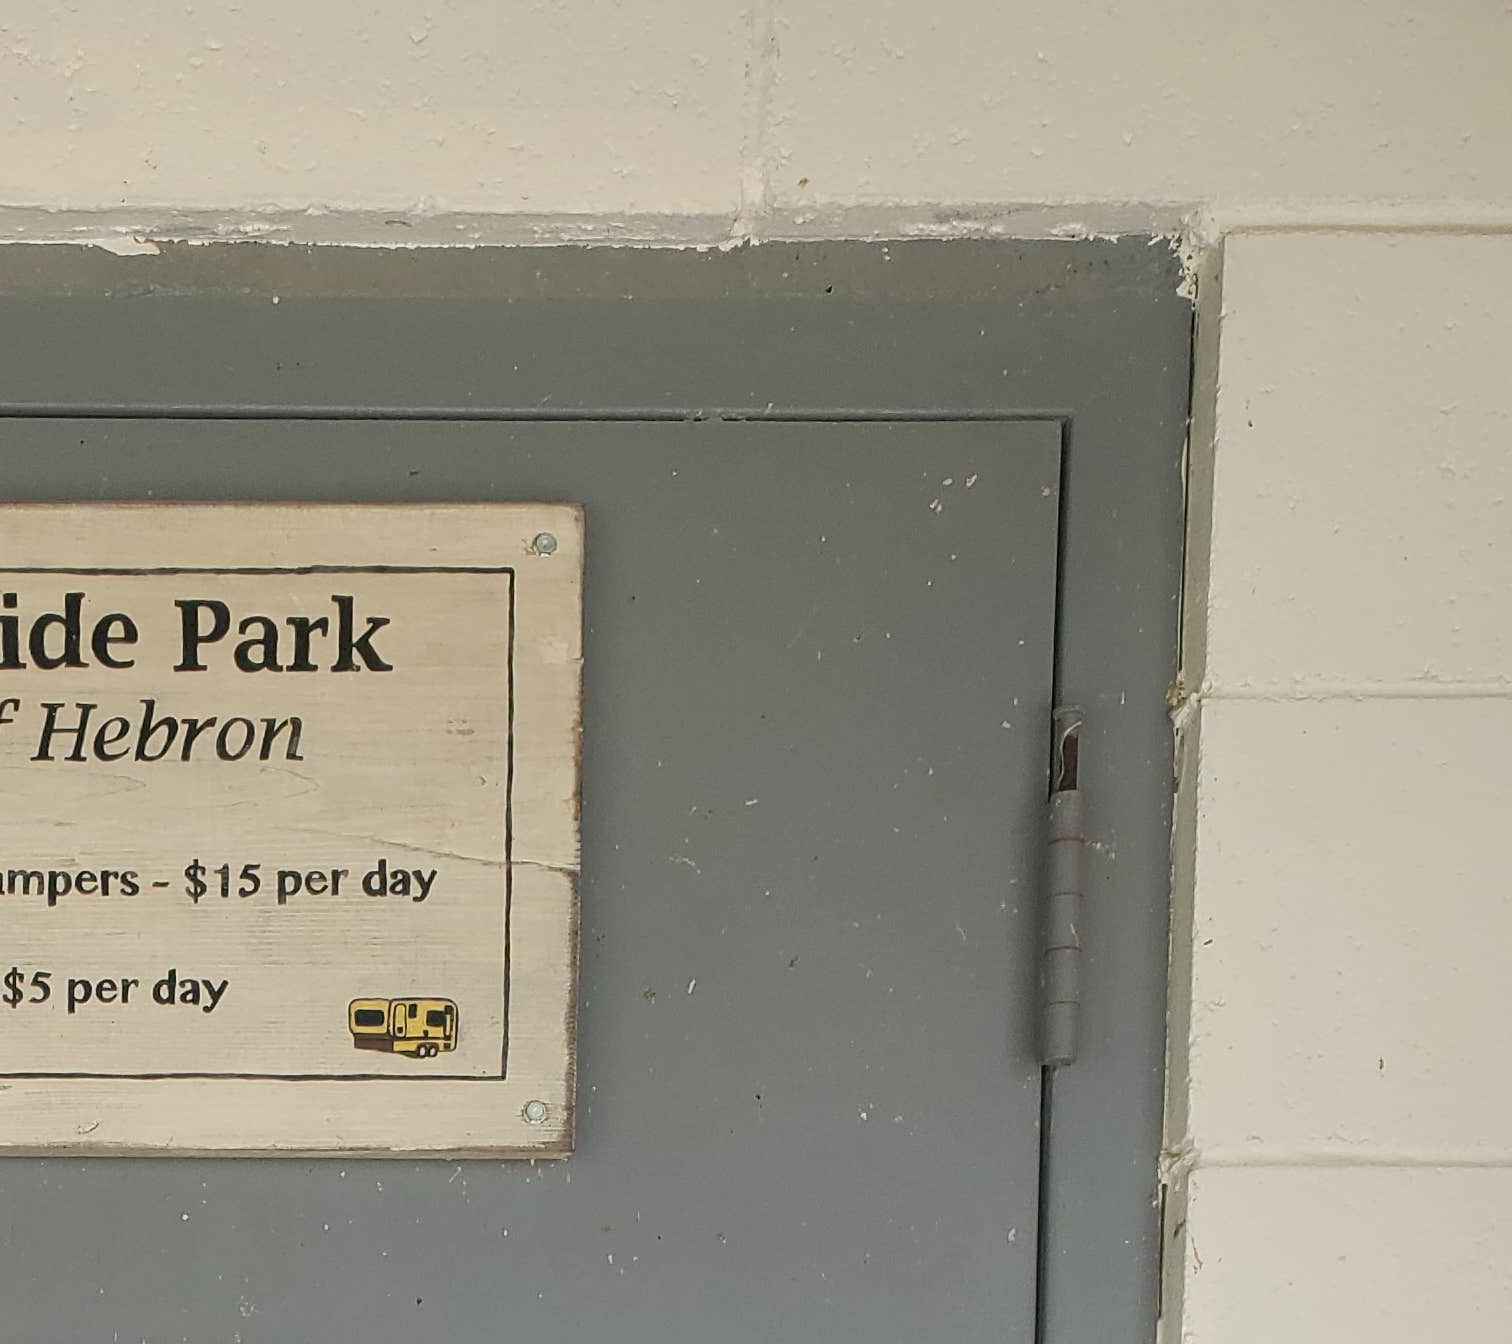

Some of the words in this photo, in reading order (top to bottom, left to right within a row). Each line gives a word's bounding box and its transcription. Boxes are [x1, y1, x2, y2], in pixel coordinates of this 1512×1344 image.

[174, 595, 393, 672] Park
[30, 699, 303, 762] Hebron
[185, 859, 260, 904] $15
[277, 870, 348, 905] per
[362, 859, 437, 902] day
[3, 967, 51, 1008] $5
[68, 979, 139, 1014] per
[153, 969, 228, 1013] day
